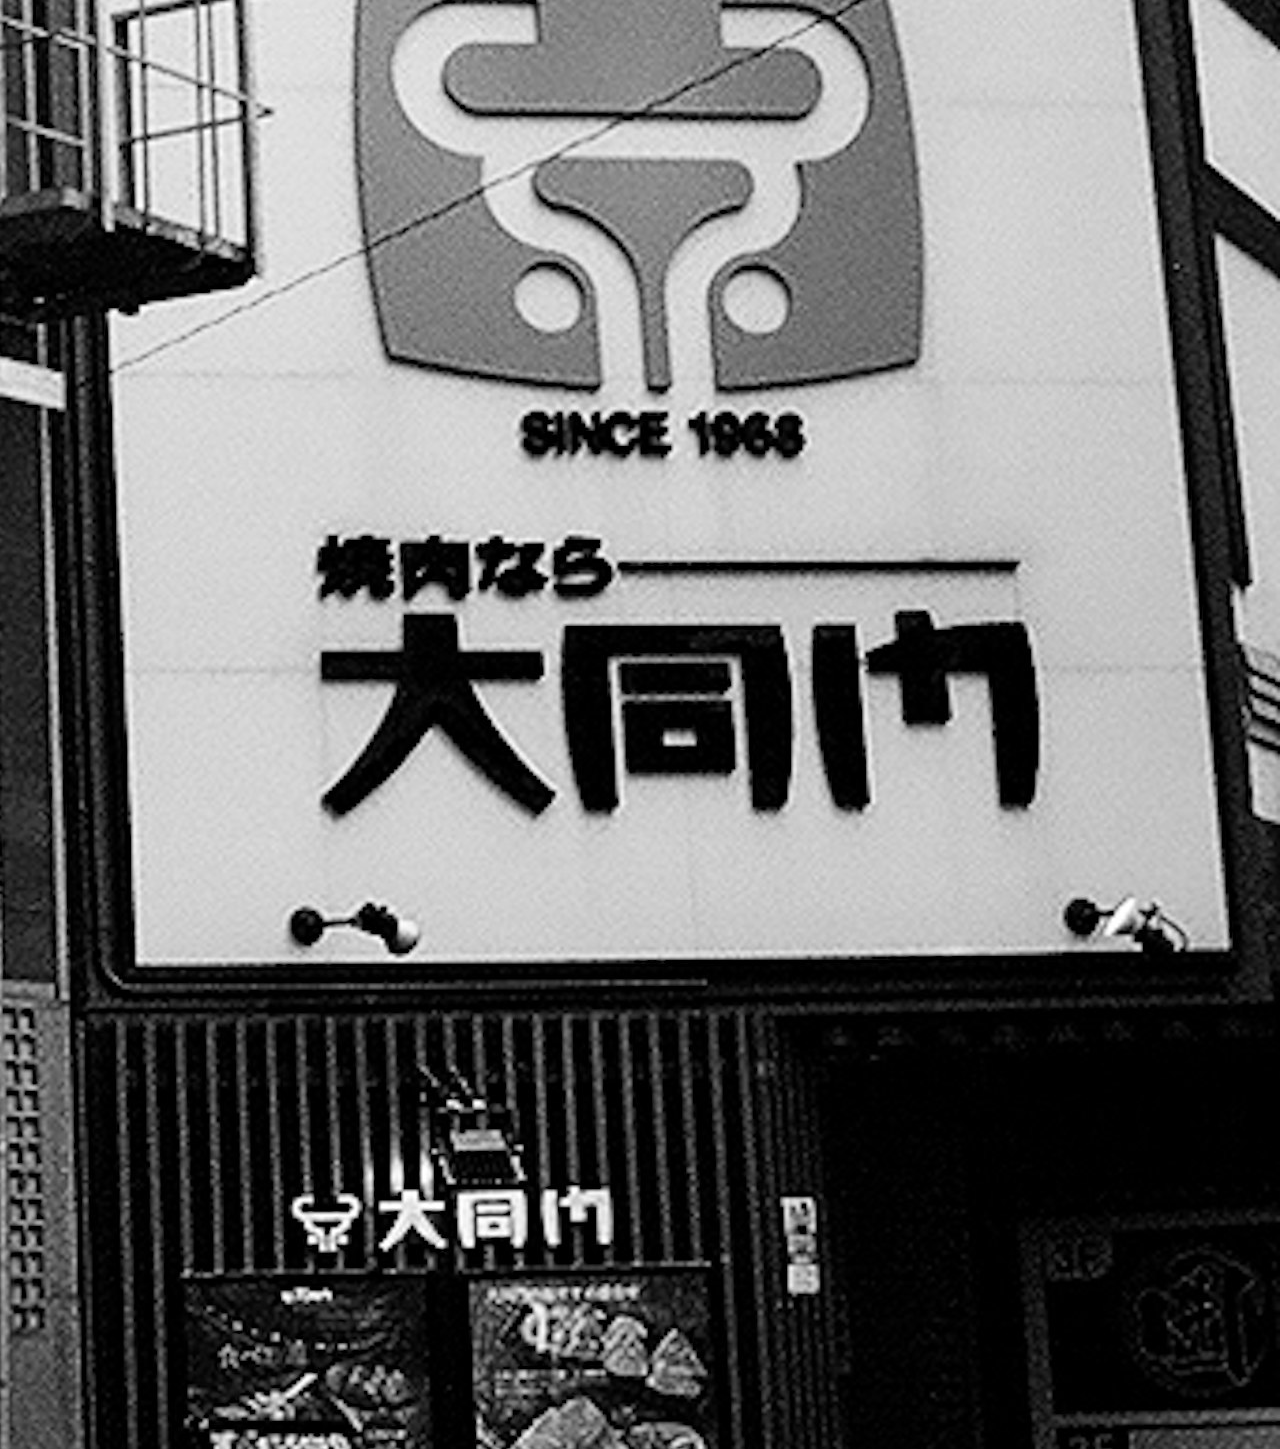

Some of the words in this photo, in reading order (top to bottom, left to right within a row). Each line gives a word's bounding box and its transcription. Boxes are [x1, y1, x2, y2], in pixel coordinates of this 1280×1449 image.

[520, 410, 672, 458] SINCE
[688, 410, 806, 458] 1968
[317, 535, 618, 602] 焼肉なら
[319, 607, 1040, 819] 大同門
[377, 1186, 616, 1251] 大同門
